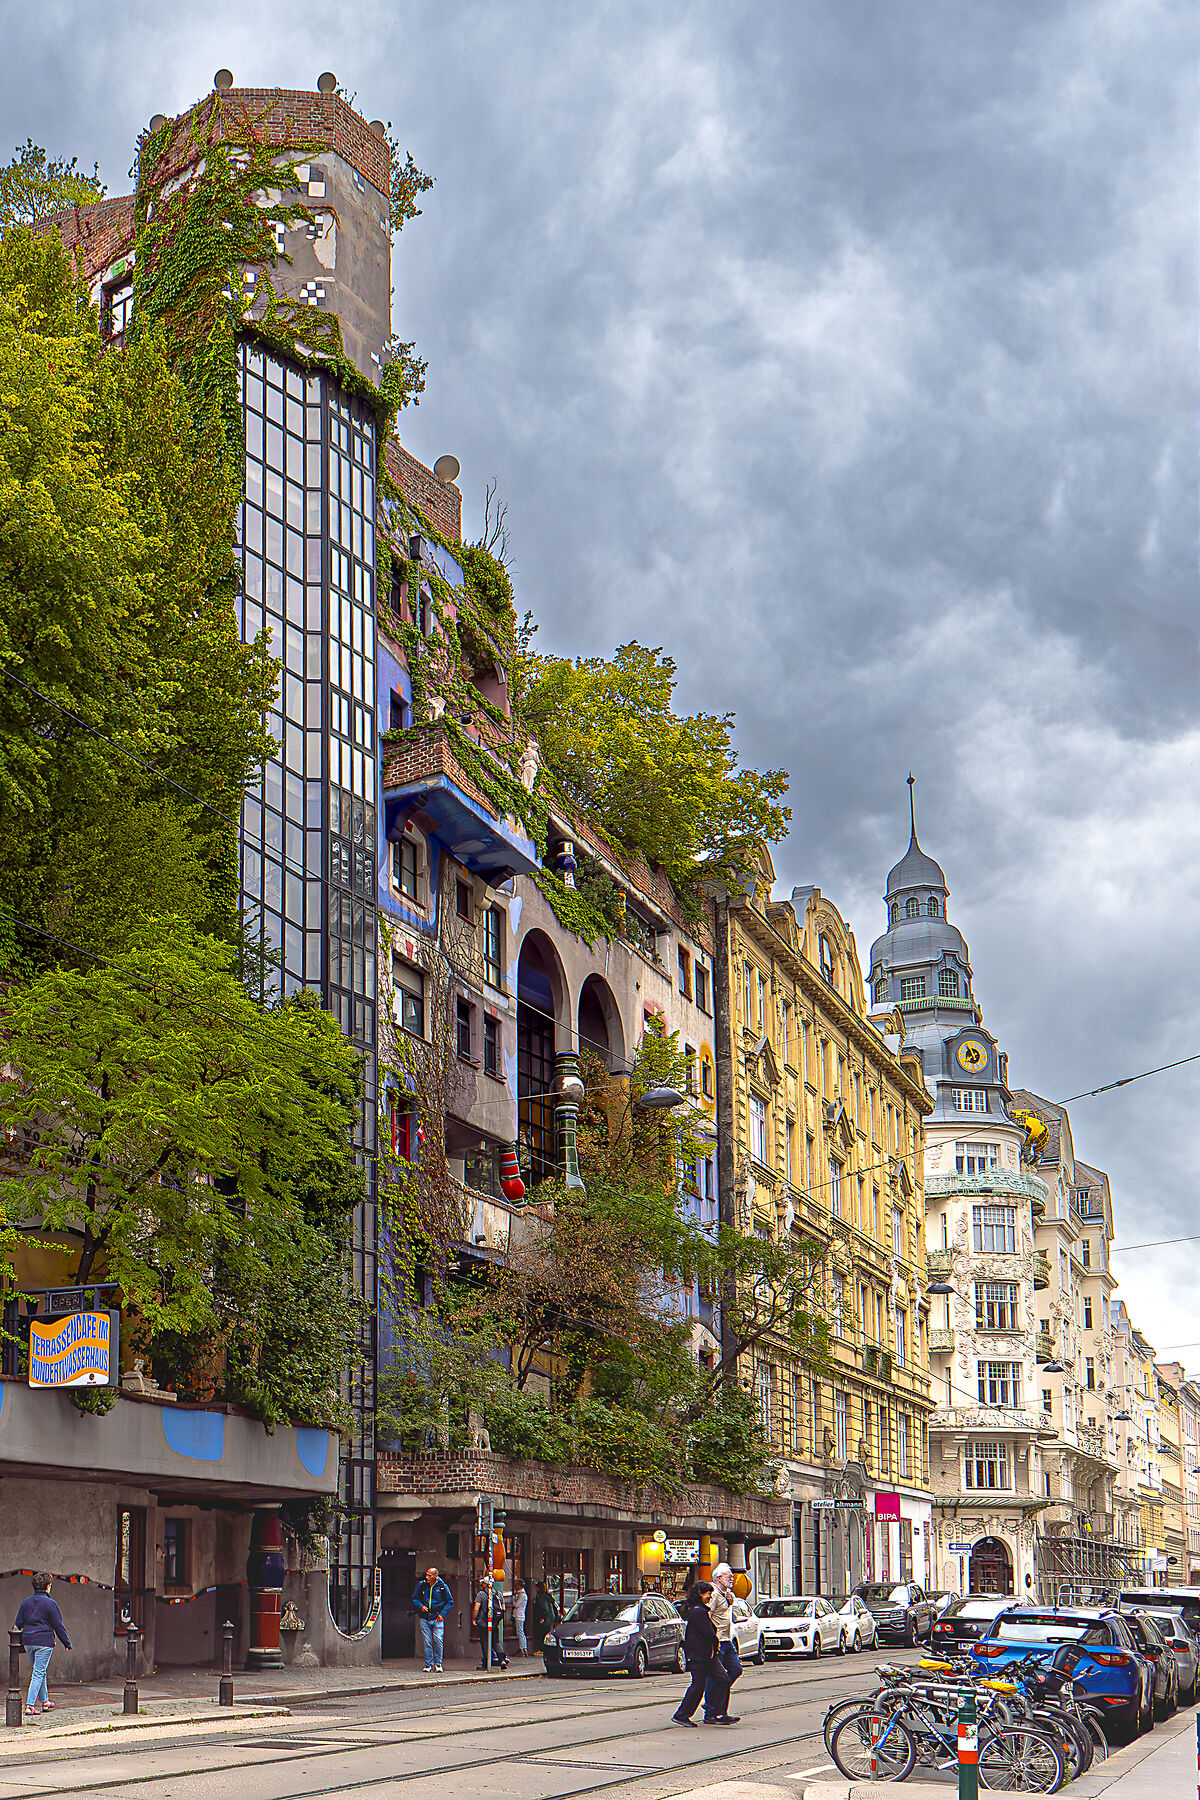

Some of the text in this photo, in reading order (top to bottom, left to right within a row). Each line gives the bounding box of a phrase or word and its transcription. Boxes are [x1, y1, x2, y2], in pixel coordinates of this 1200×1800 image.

[32, 1314, 109, 1357] TERRASSENCAFE IM
[31, 1346, 109, 1383] HUNDERTWASSERHAUS
[877, 1513, 898, 1521] BIPA
